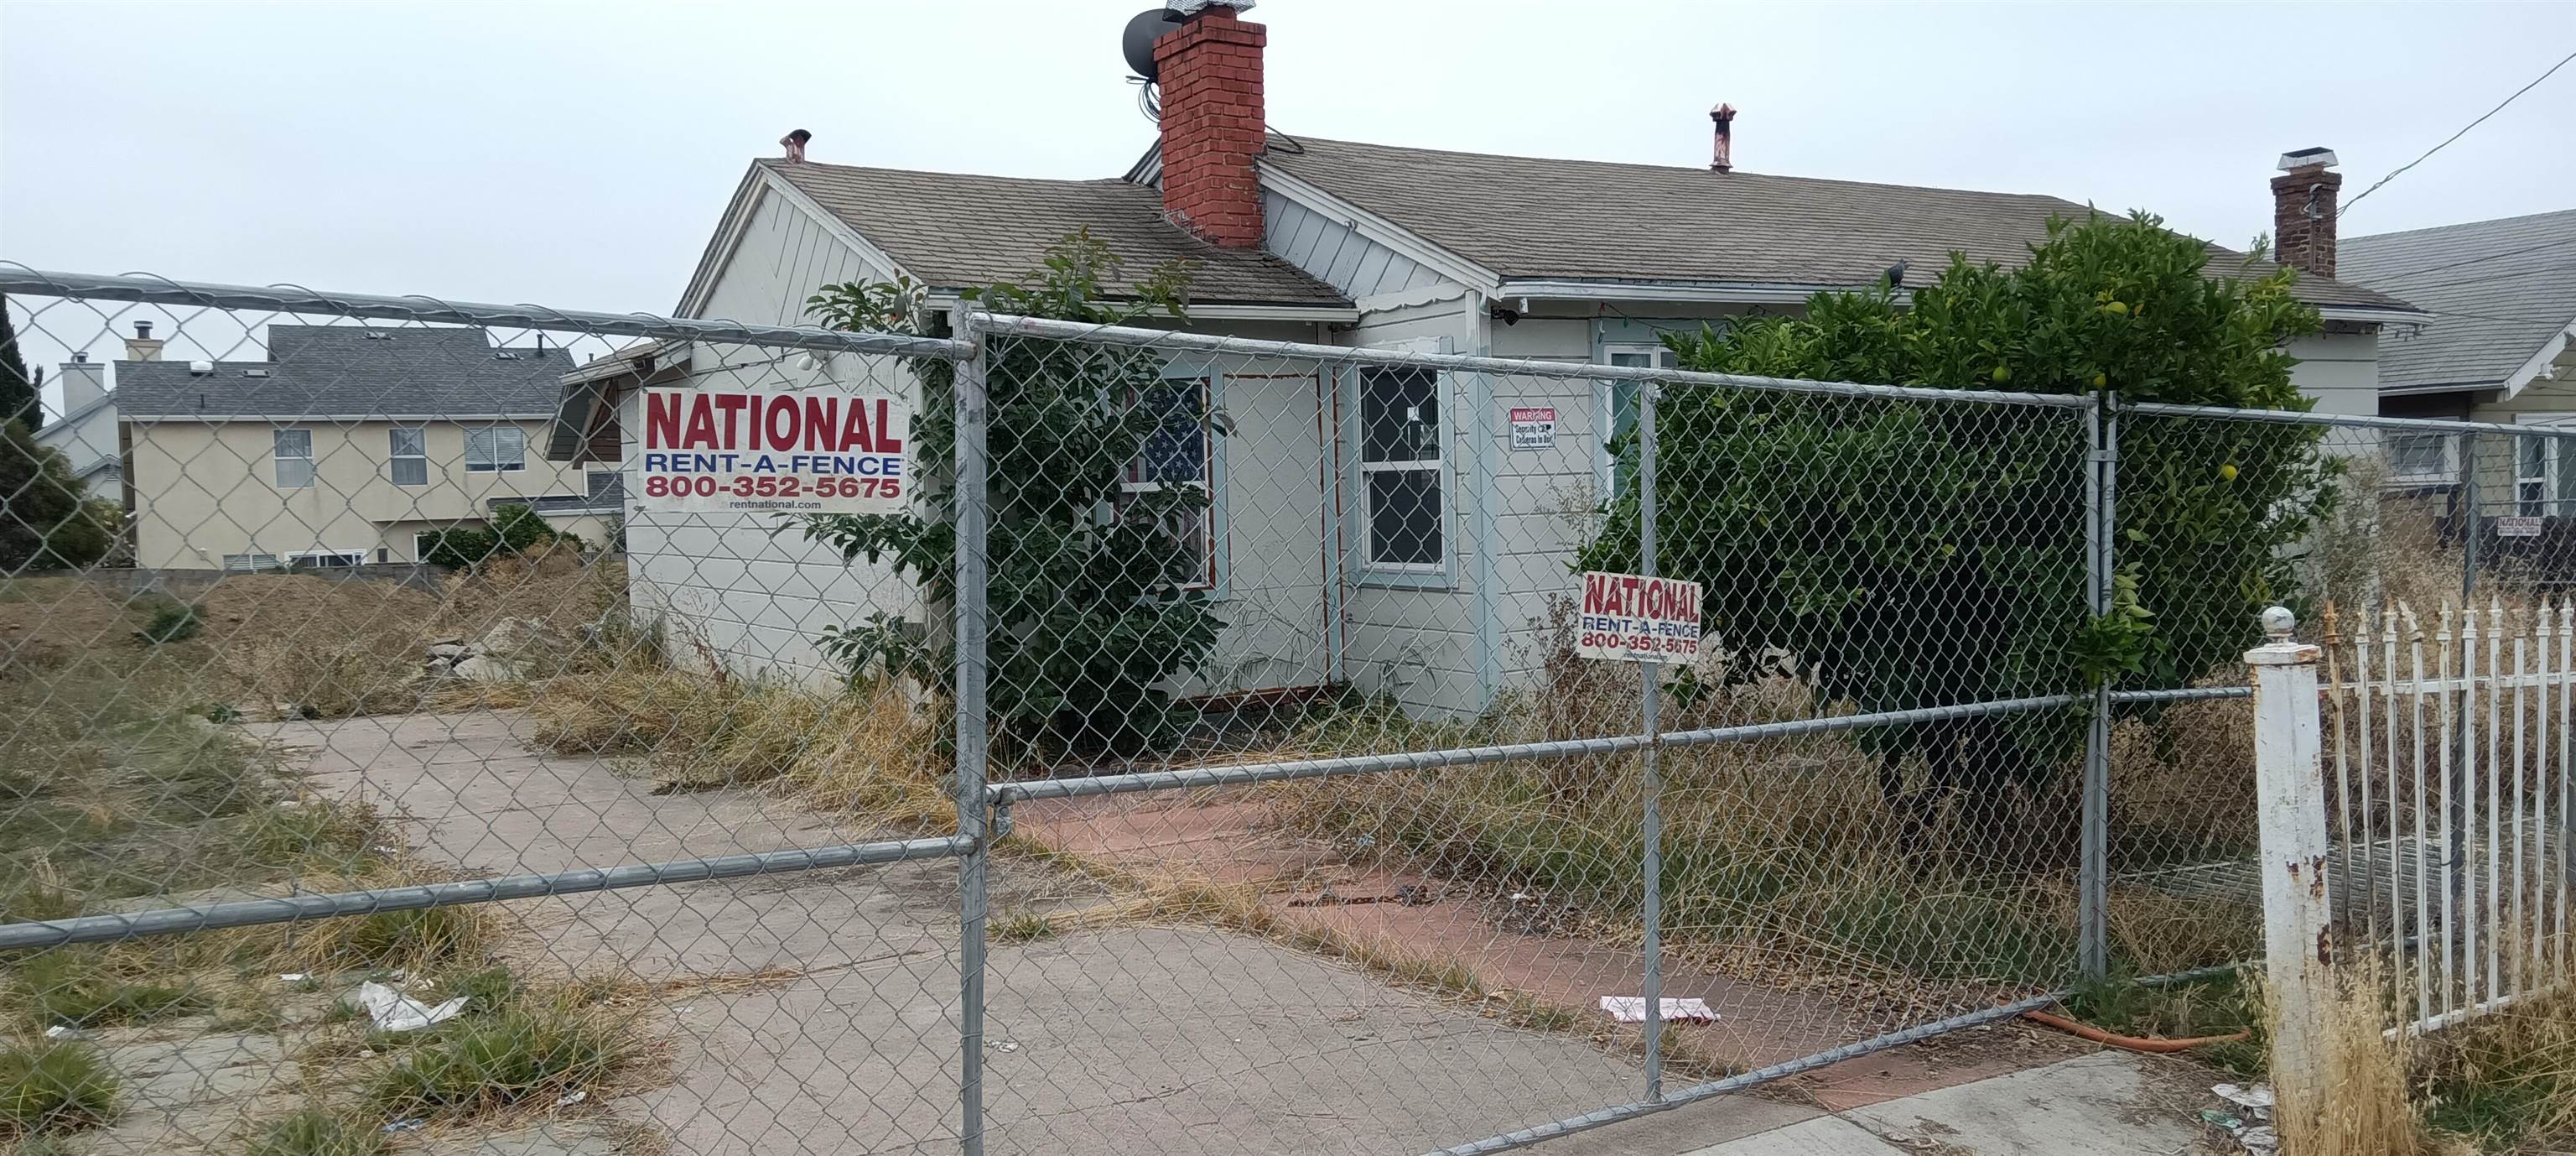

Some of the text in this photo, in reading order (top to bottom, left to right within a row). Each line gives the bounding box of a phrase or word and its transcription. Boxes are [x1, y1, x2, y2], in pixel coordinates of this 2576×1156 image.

[647, 393, 902, 454] NATIONAL
[645, 453, 901, 476] RENT-A-FENCE
[645, 476, 901, 498] 800-352-5675
[730, 500, 822, 510] rentnational.com
[2499, 518, 2540, 527] NATIONAL
[1584, 574, 1699, 622] NATIONAL
[1582, 617, 1700, 638] RENT-A-FENCE
[1581, 632, 1697, 654] 800-352-5675
